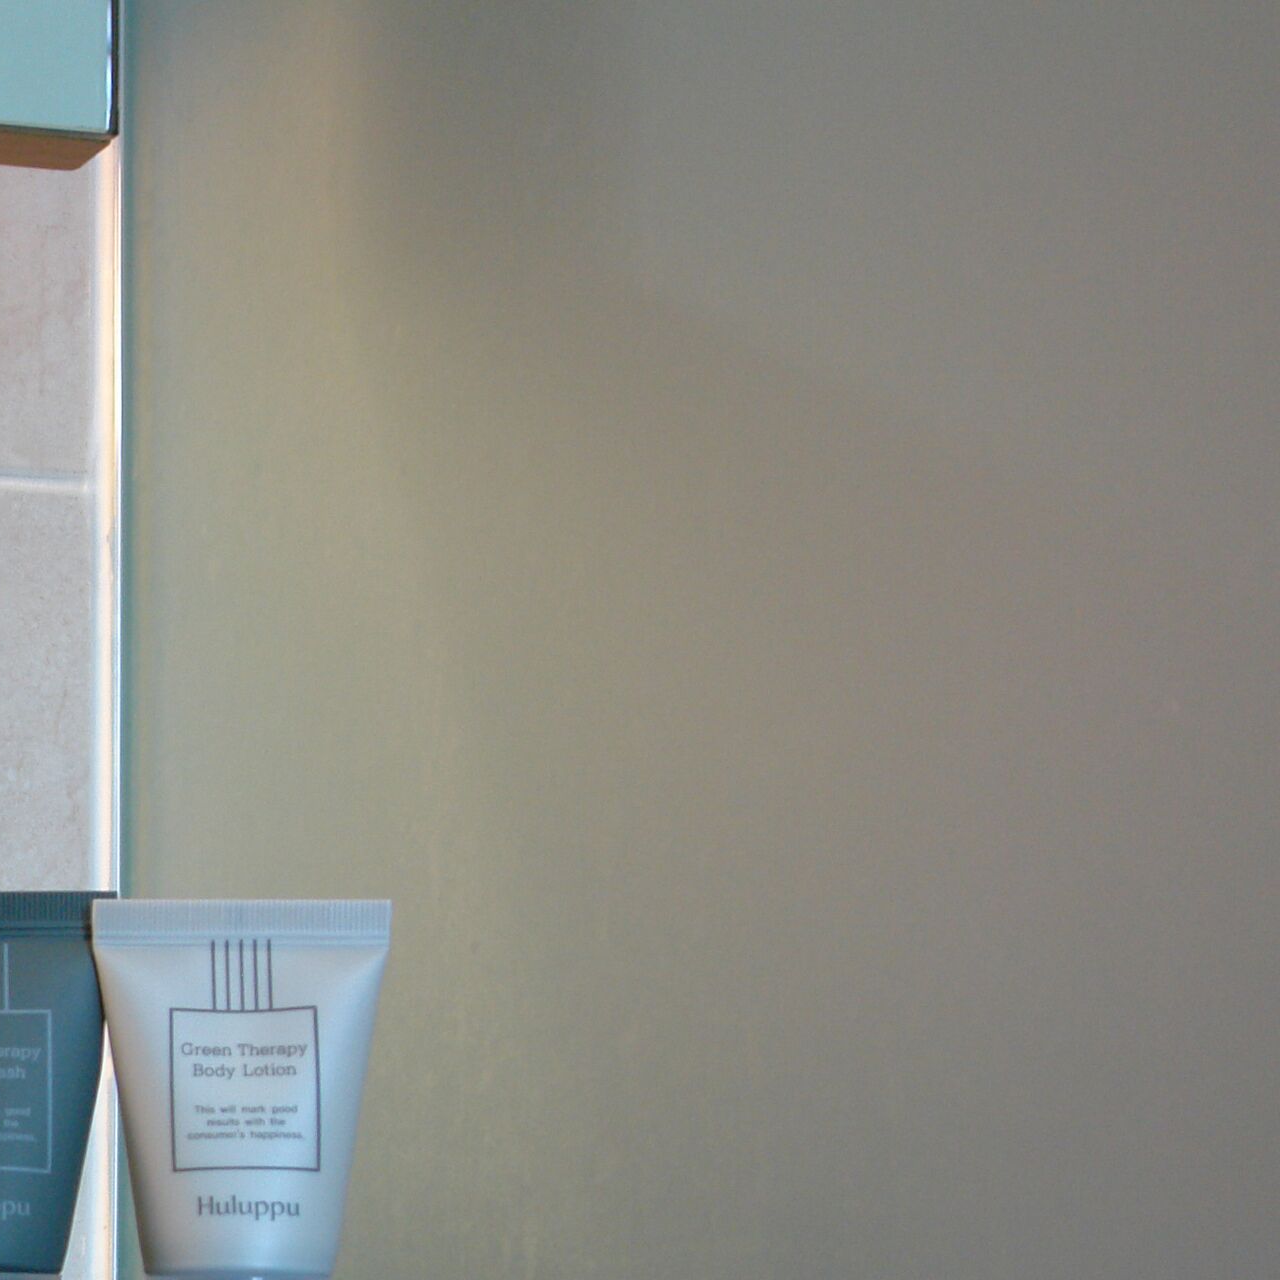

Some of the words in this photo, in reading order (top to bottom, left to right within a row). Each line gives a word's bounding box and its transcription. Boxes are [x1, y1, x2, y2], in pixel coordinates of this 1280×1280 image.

[181, 1042, 232, 1056] Green
[237, 1044, 308, 1058] Therapy
[193, 1064, 235, 1080] Body
[243, 1063, 297, 1077] Lotion
[198, 1196, 300, 1221] Huluppu
